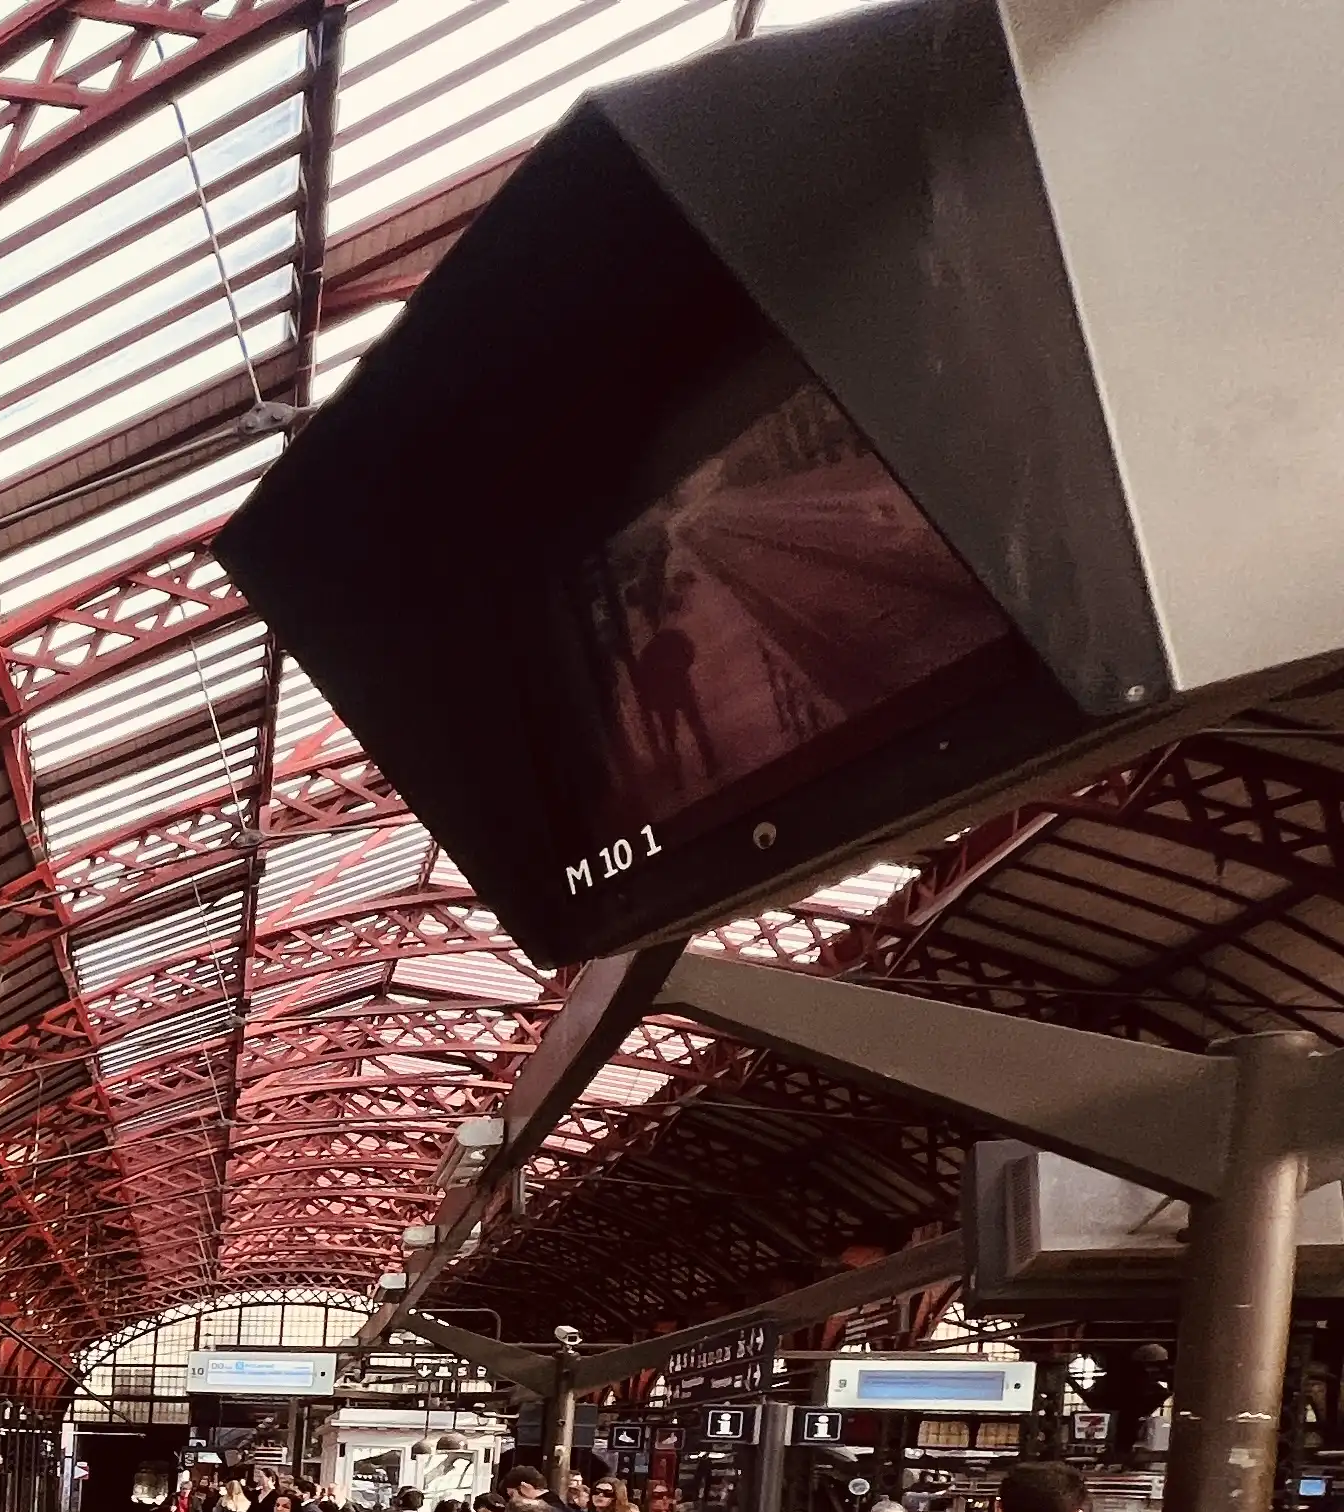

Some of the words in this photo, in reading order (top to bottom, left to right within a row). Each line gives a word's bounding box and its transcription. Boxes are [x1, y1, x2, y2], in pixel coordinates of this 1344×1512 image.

[565, 858, 593, 895] M
[599, 838, 633, 879] 10
[640, 824, 663, 857] 1
[190, 1367, 205, 1376] 10
